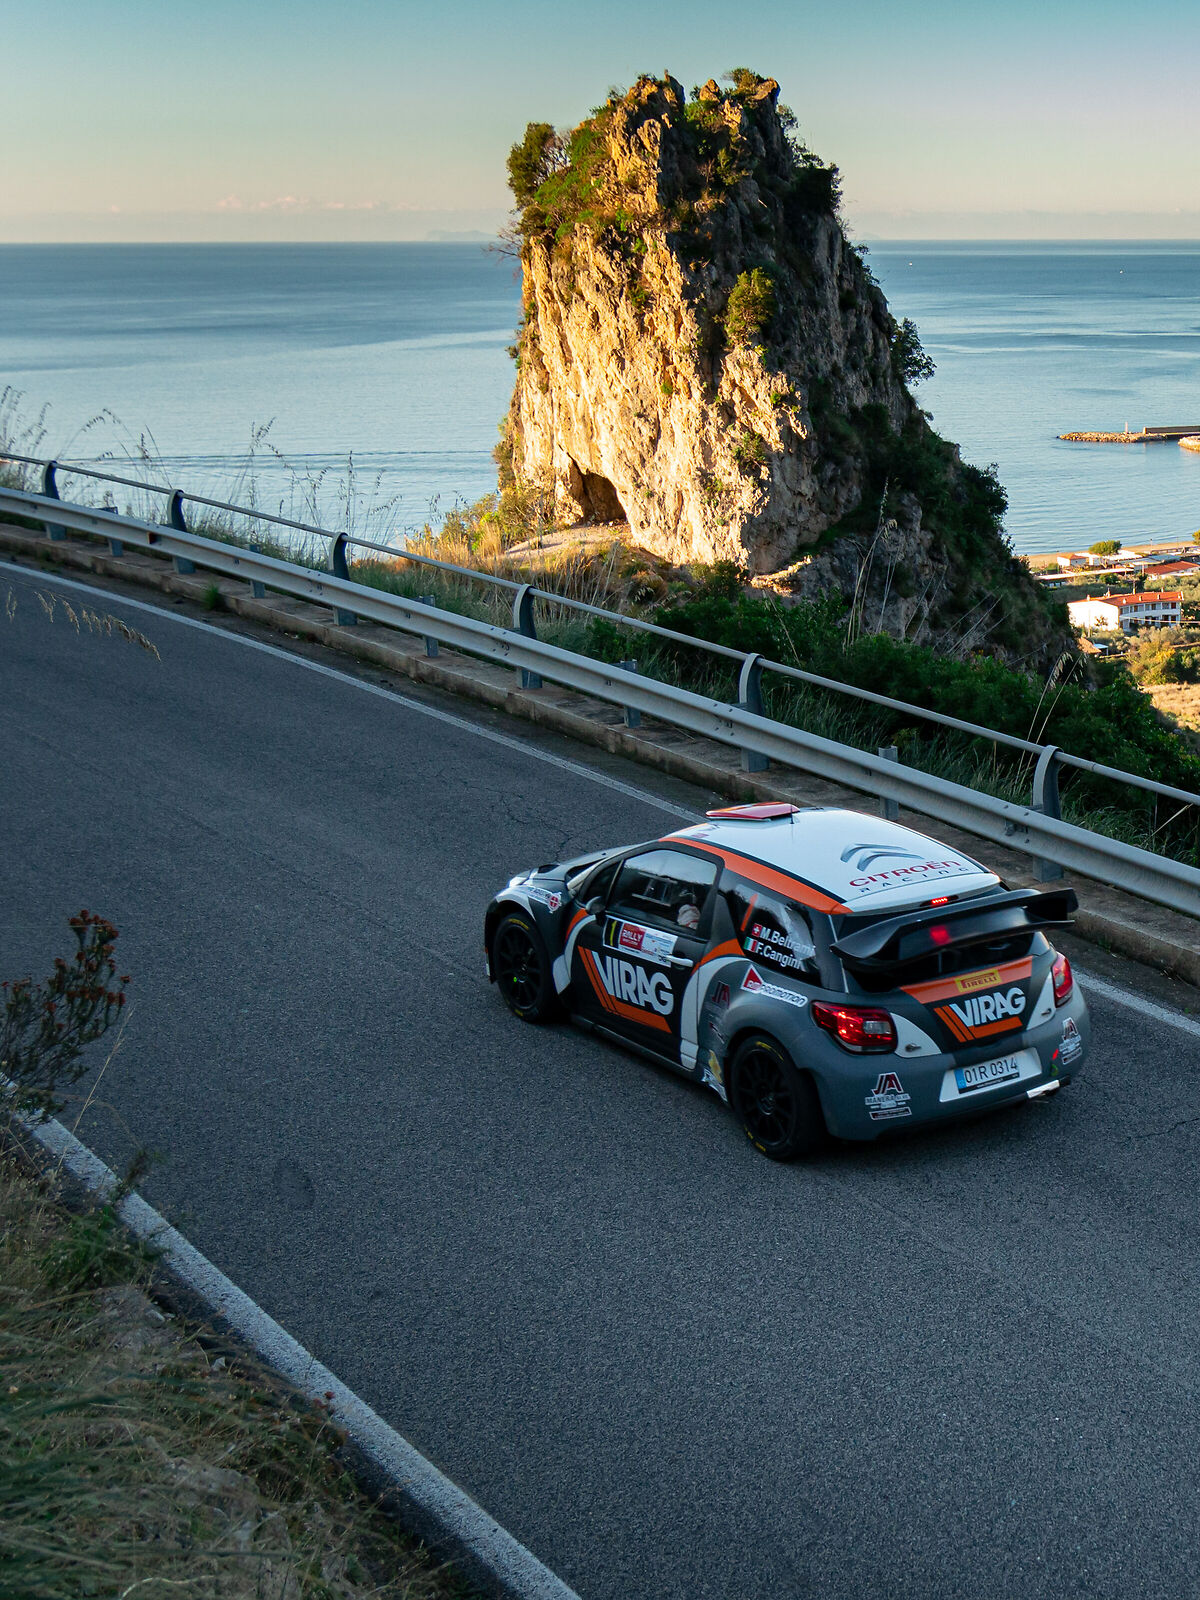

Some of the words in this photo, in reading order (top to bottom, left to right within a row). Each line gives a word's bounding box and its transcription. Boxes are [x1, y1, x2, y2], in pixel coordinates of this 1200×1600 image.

[849, 860, 961, 887] CITROËN
[860, 867, 969, 893] RACING
[609, 920, 617, 946] 1
[591, 950, 675, 1016] VIRAG
[961, 972, 998, 989] PIRELLI
[949, 987, 1027, 1027] VIRAG
[964, 1065, 989, 1084] 01R
[990, 1057, 1018, 1077] 0314
